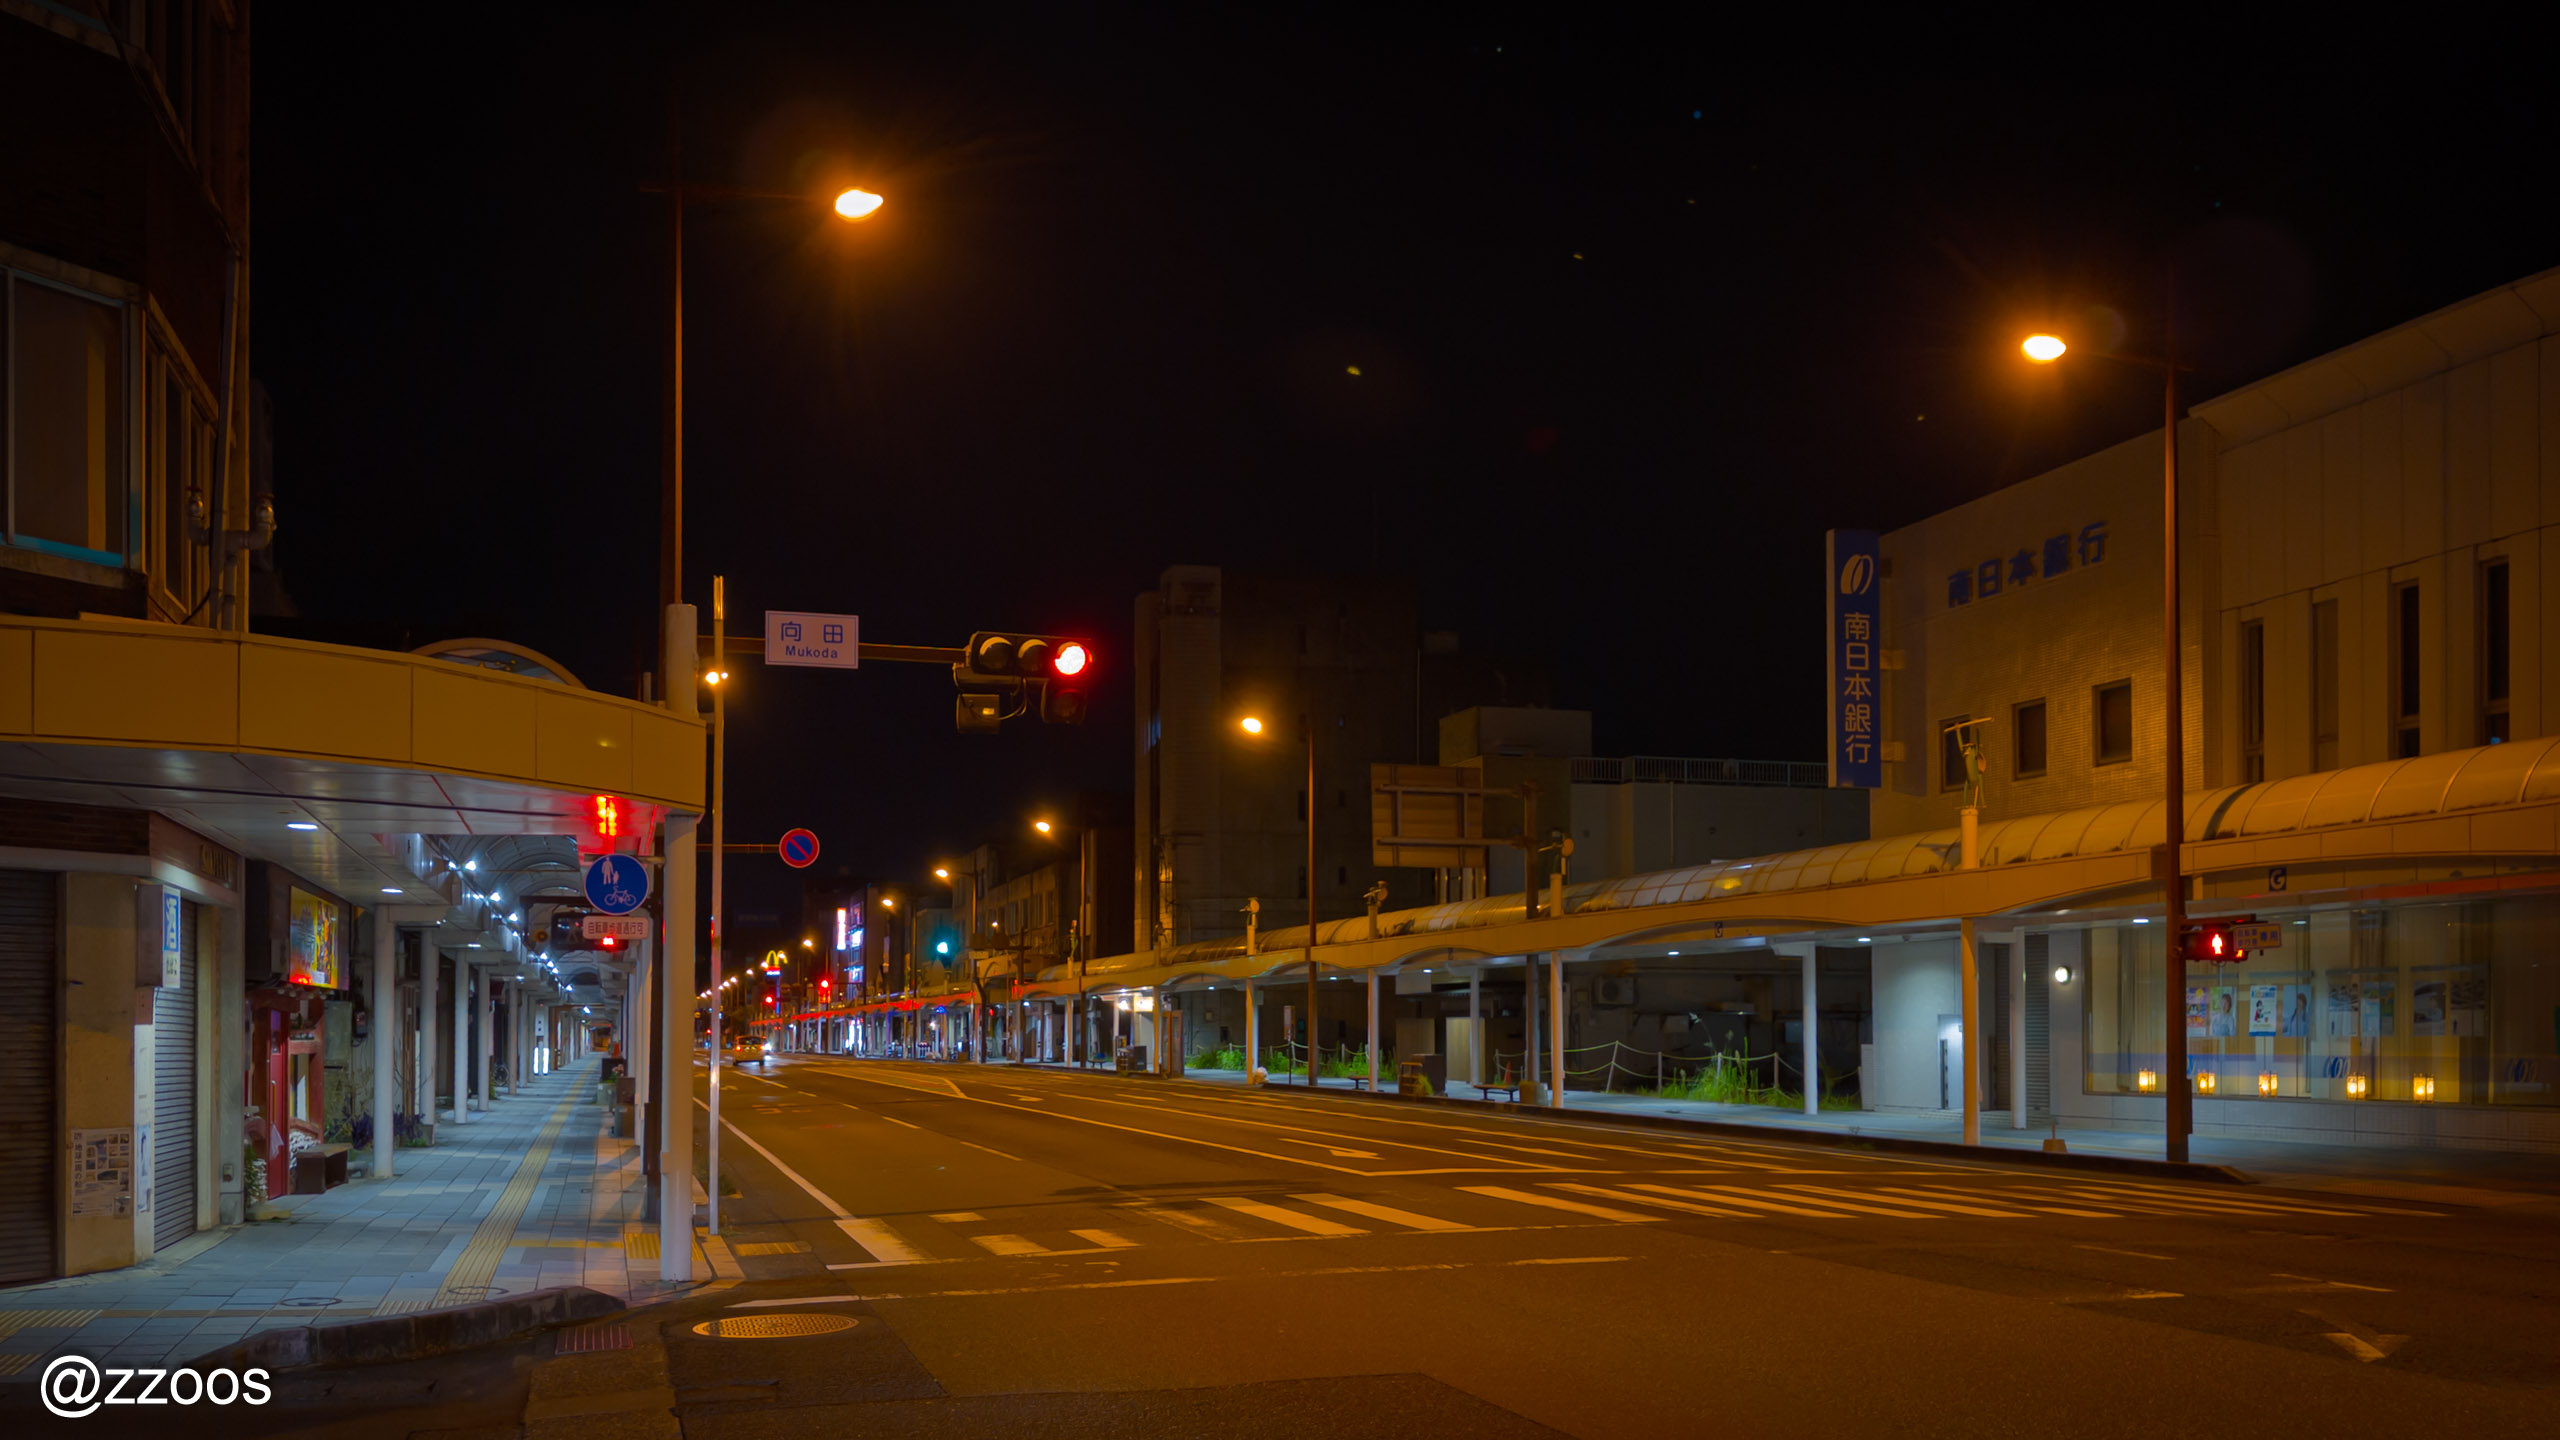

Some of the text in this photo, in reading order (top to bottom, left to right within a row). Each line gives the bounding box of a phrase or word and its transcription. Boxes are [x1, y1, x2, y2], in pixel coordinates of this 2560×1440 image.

[1948, 522, 2107, 608] 南日本銀行
[781, 621, 843, 644] 向田
[786, 645, 838, 659] Mukoda
[1844, 611, 1871, 763] 南日本銀行
